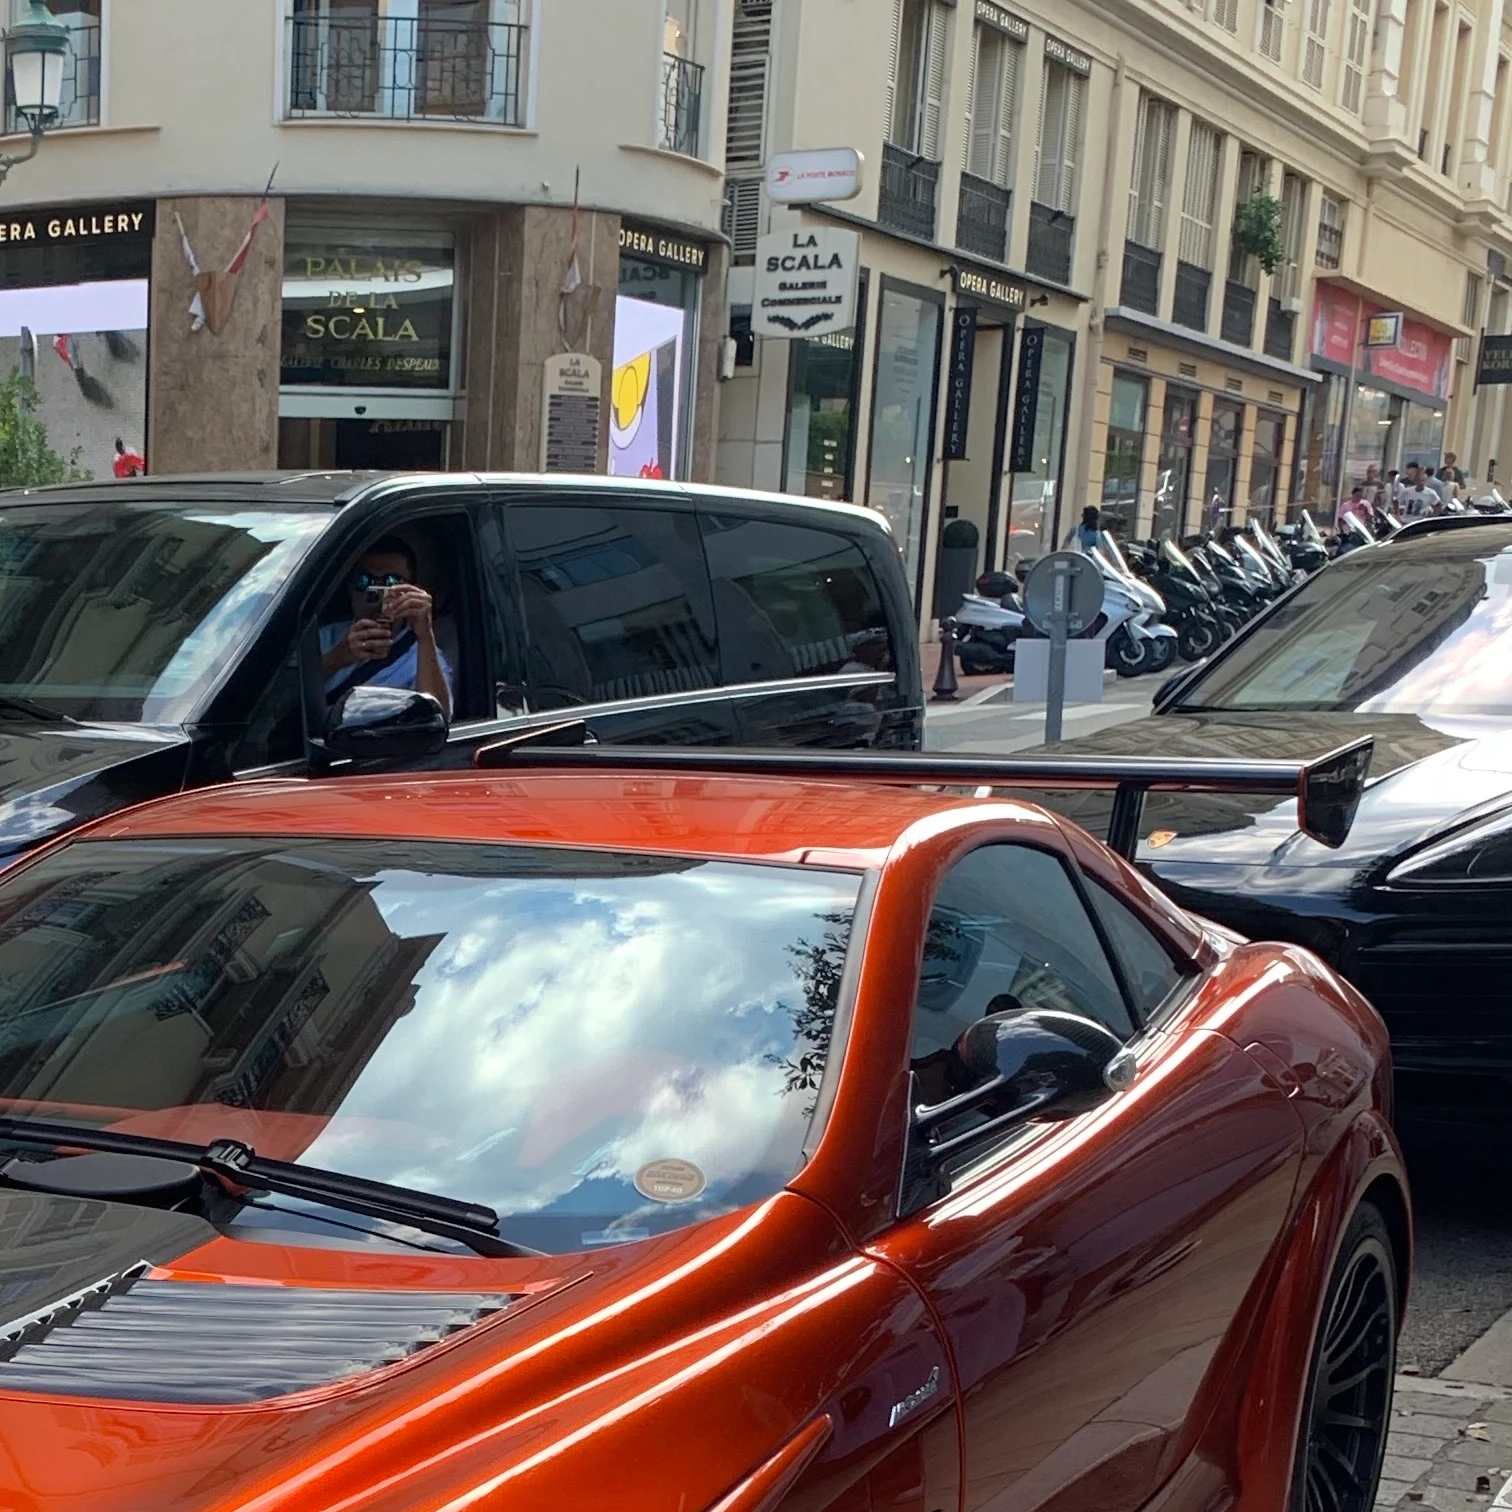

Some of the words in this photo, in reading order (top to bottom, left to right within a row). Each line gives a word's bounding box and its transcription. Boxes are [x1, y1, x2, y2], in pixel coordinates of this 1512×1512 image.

[47, 212, 143, 238] GALLERY
[618, 229, 653, 254] OPERA
[658, 240, 705, 267] GALLERY
[792, 233, 818, 249] LA
[305, 257, 423, 283] PALAIS
[766, 252, 843, 272] SCALA
[778, 280, 827, 291] GALERIE
[960, 271, 987, 294] OPERA
[989, 281, 1024, 306] GALLERY
[328, 290, 357, 308] DE
[369, 291, 399, 309] LA
[306, 315, 420, 341] SCALA
[956, 314, 971, 371] OPERA
[1024, 335, 1038, 388] OPERA
[951, 379, 964, 453] GALLERY
[1018, 395, 1031, 466] GALLERY
